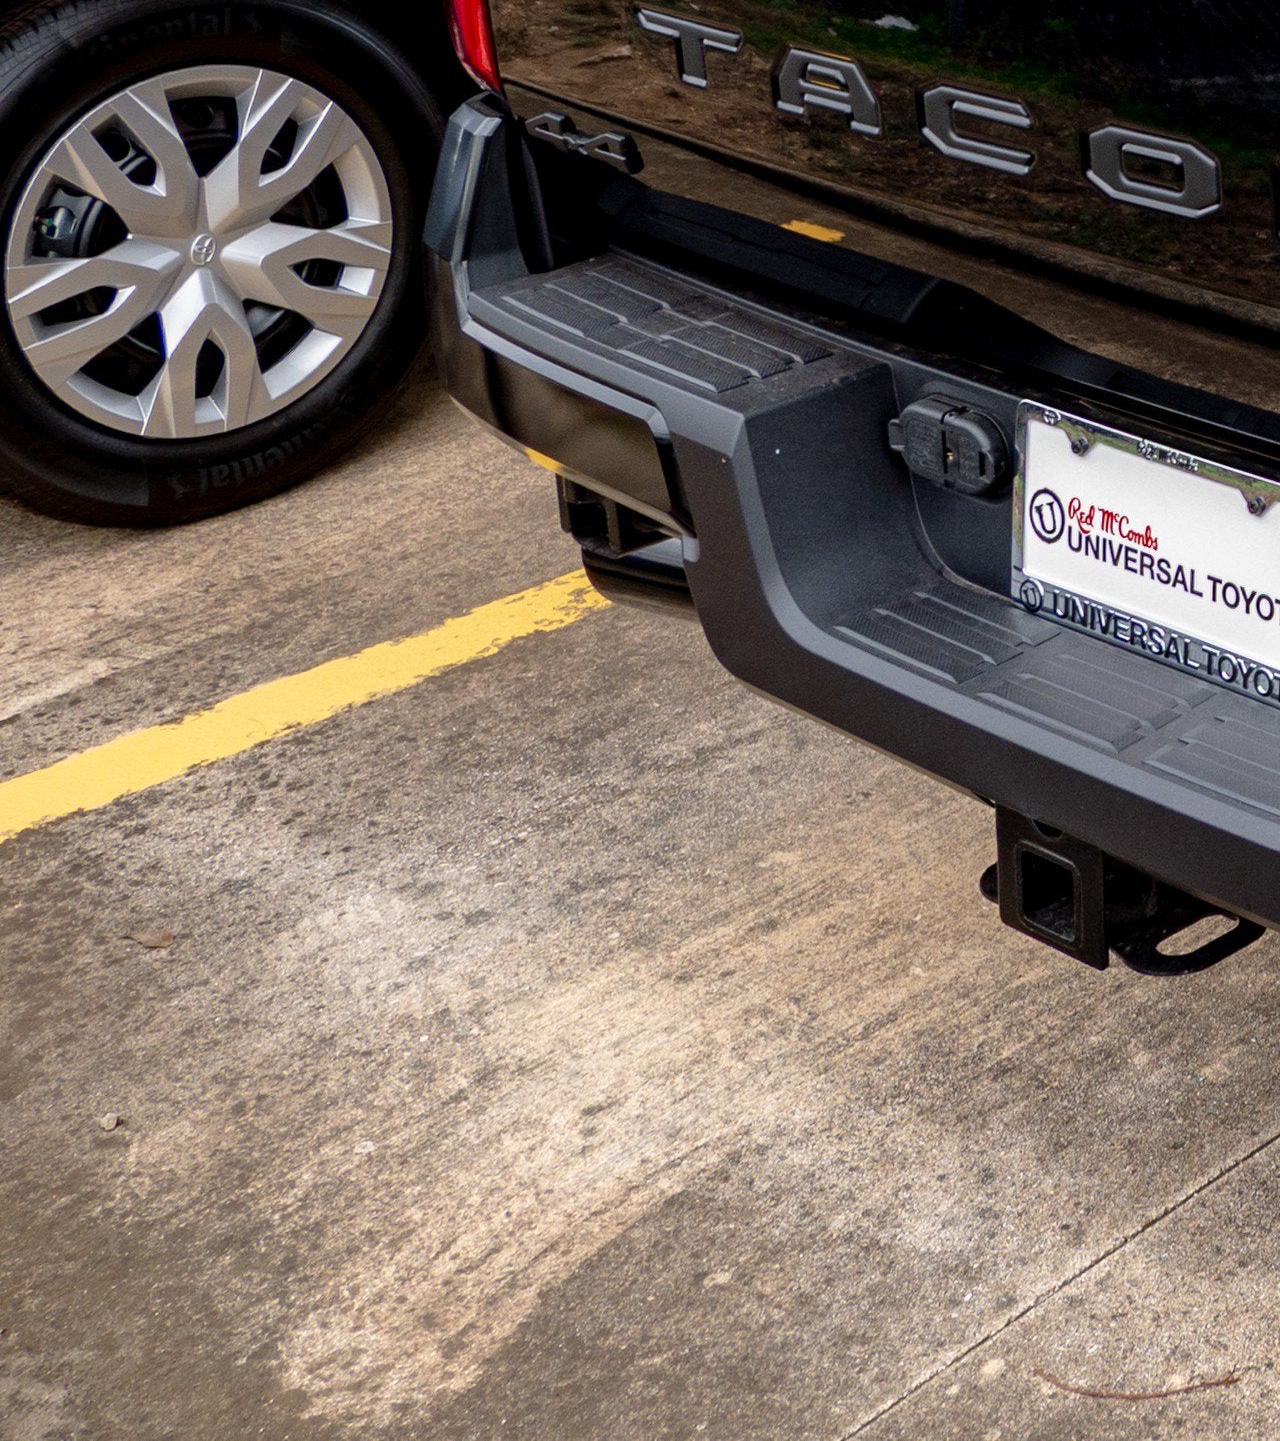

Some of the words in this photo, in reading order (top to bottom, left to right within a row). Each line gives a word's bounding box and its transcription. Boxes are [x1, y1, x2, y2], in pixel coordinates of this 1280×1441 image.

[1068, 497, 1095, 534] Red
[1098, 505, 1159, 551] McCombs
[1067, 525, 1204, 598] UNIVERSAL
[1051, 588, 1201, 670] UNIVERSAL
